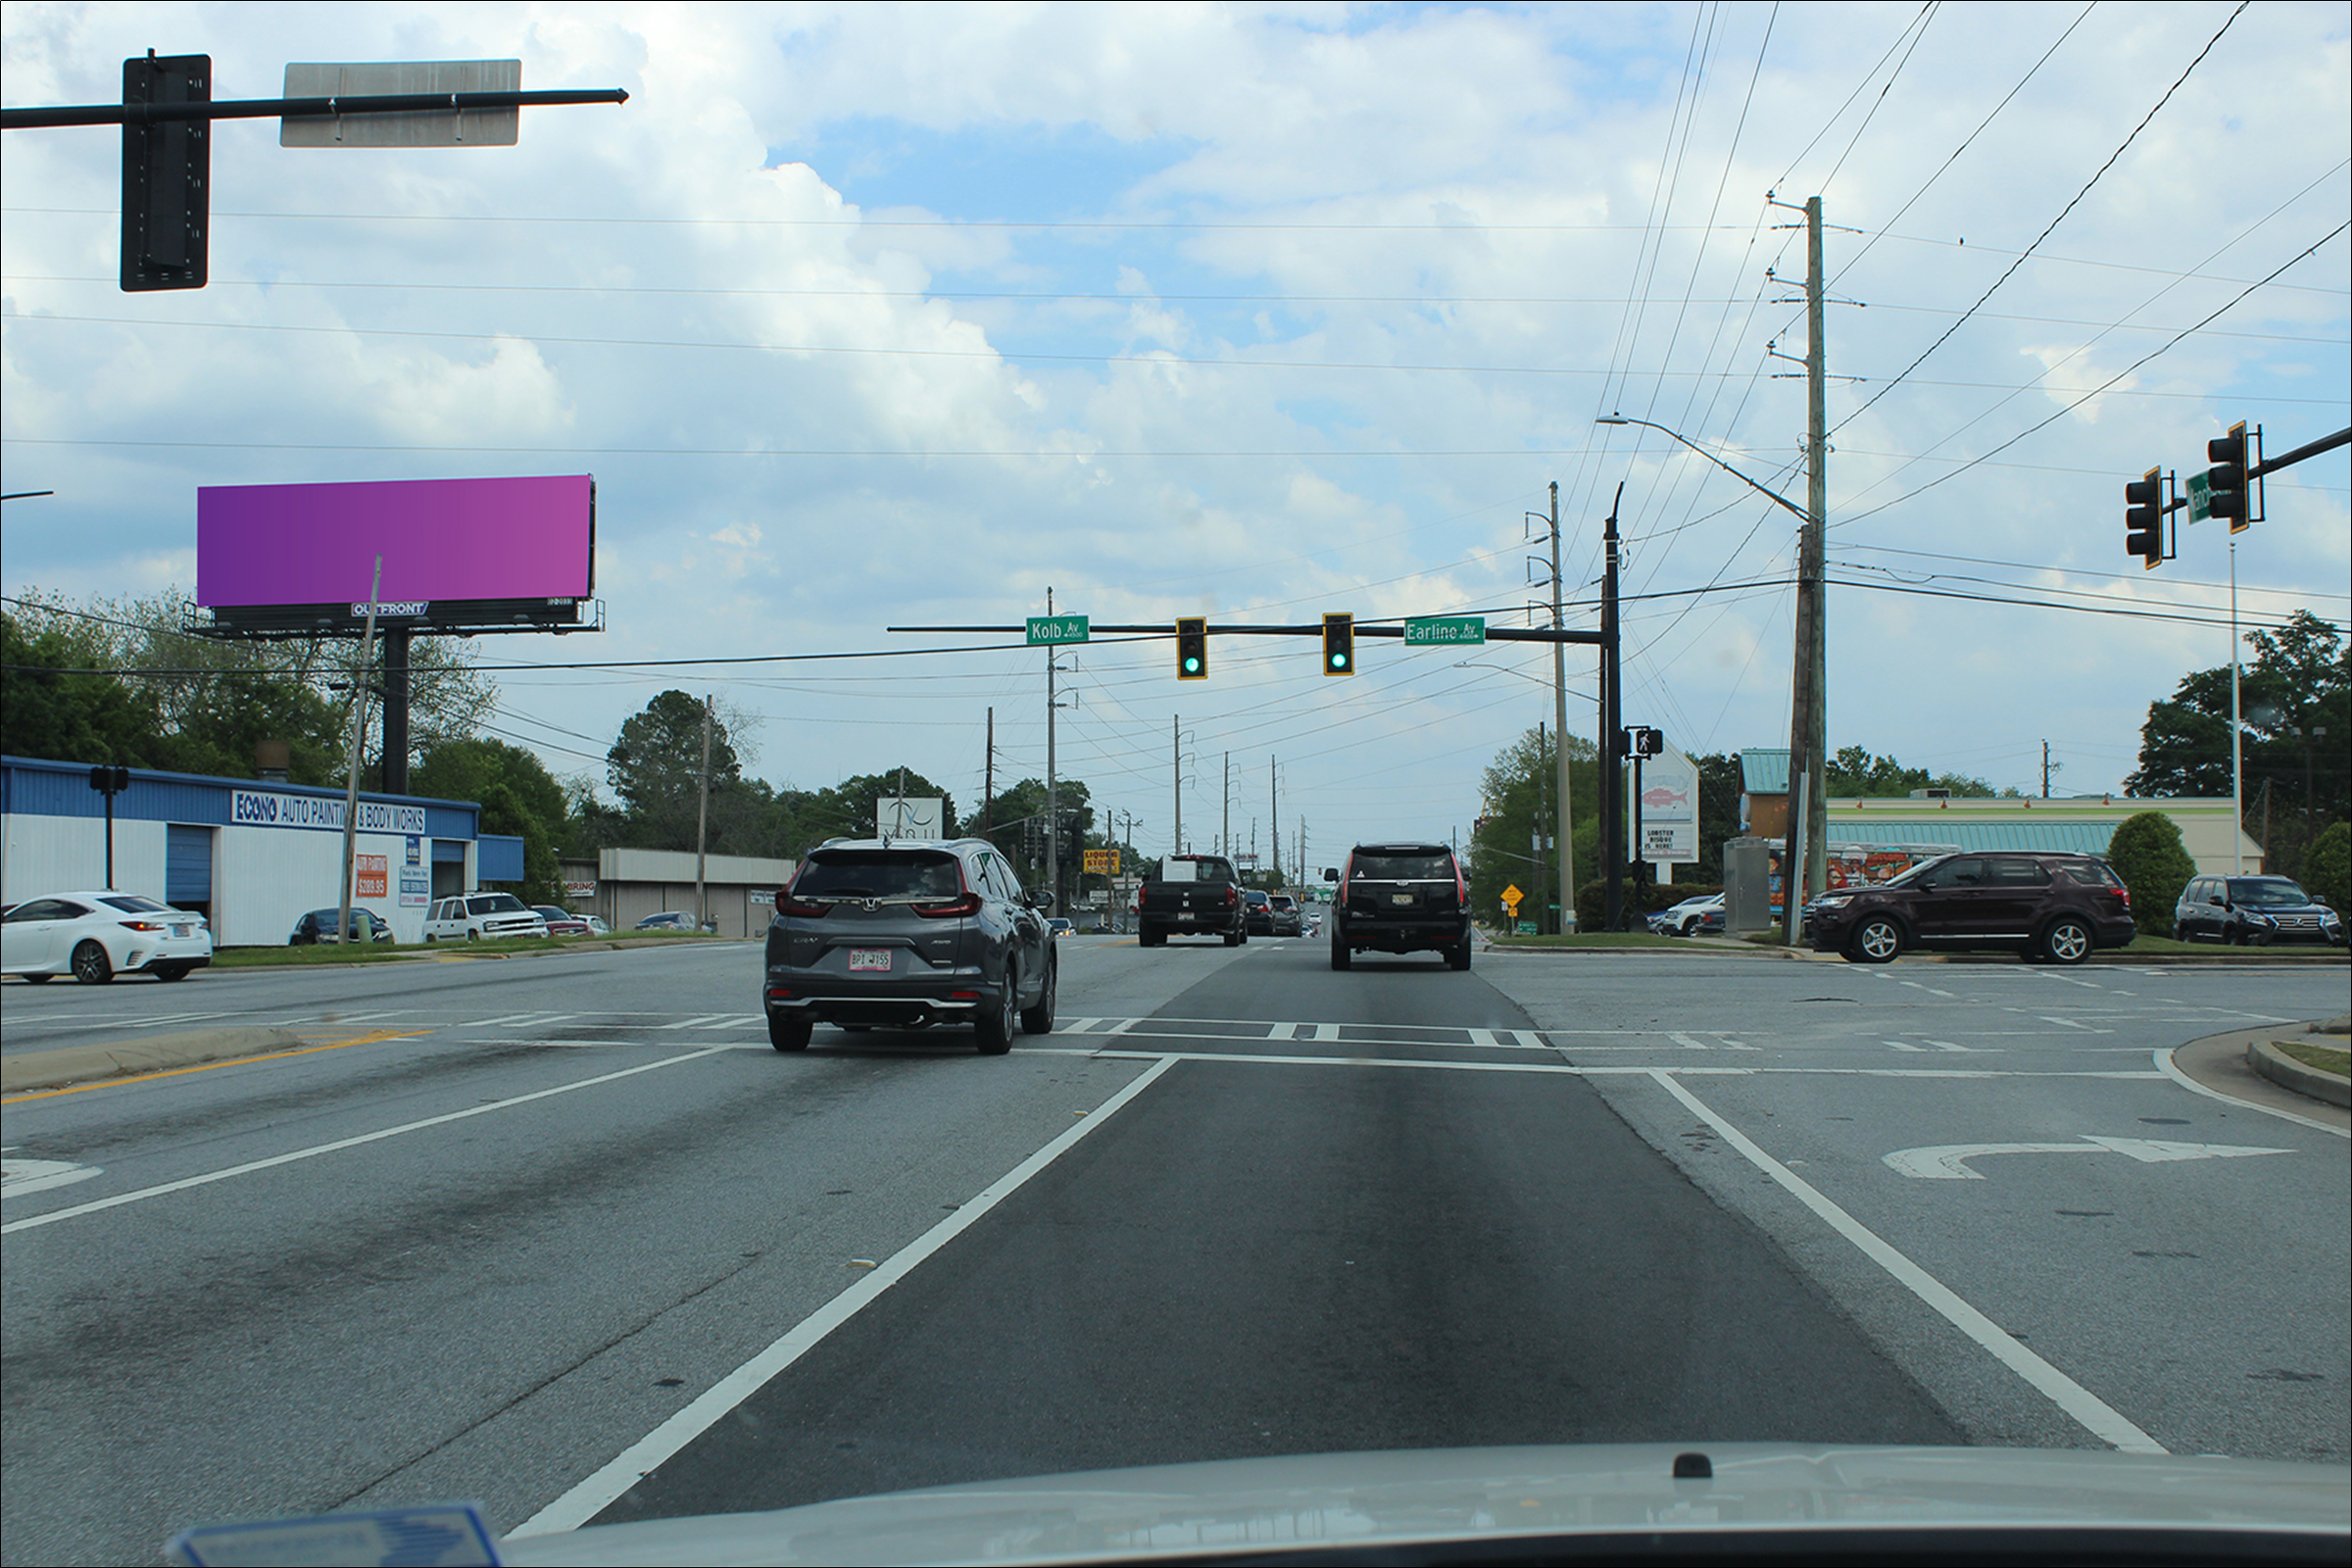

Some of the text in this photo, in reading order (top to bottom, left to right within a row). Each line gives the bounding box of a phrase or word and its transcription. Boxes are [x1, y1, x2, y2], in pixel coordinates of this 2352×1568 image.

[1032, 621, 1080, 639] Kolb Av
[1406, 622, 1476, 640] Earline Av
[236, 793, 424, 831] ECONO AUTO PAINTI & BODY WORKS
